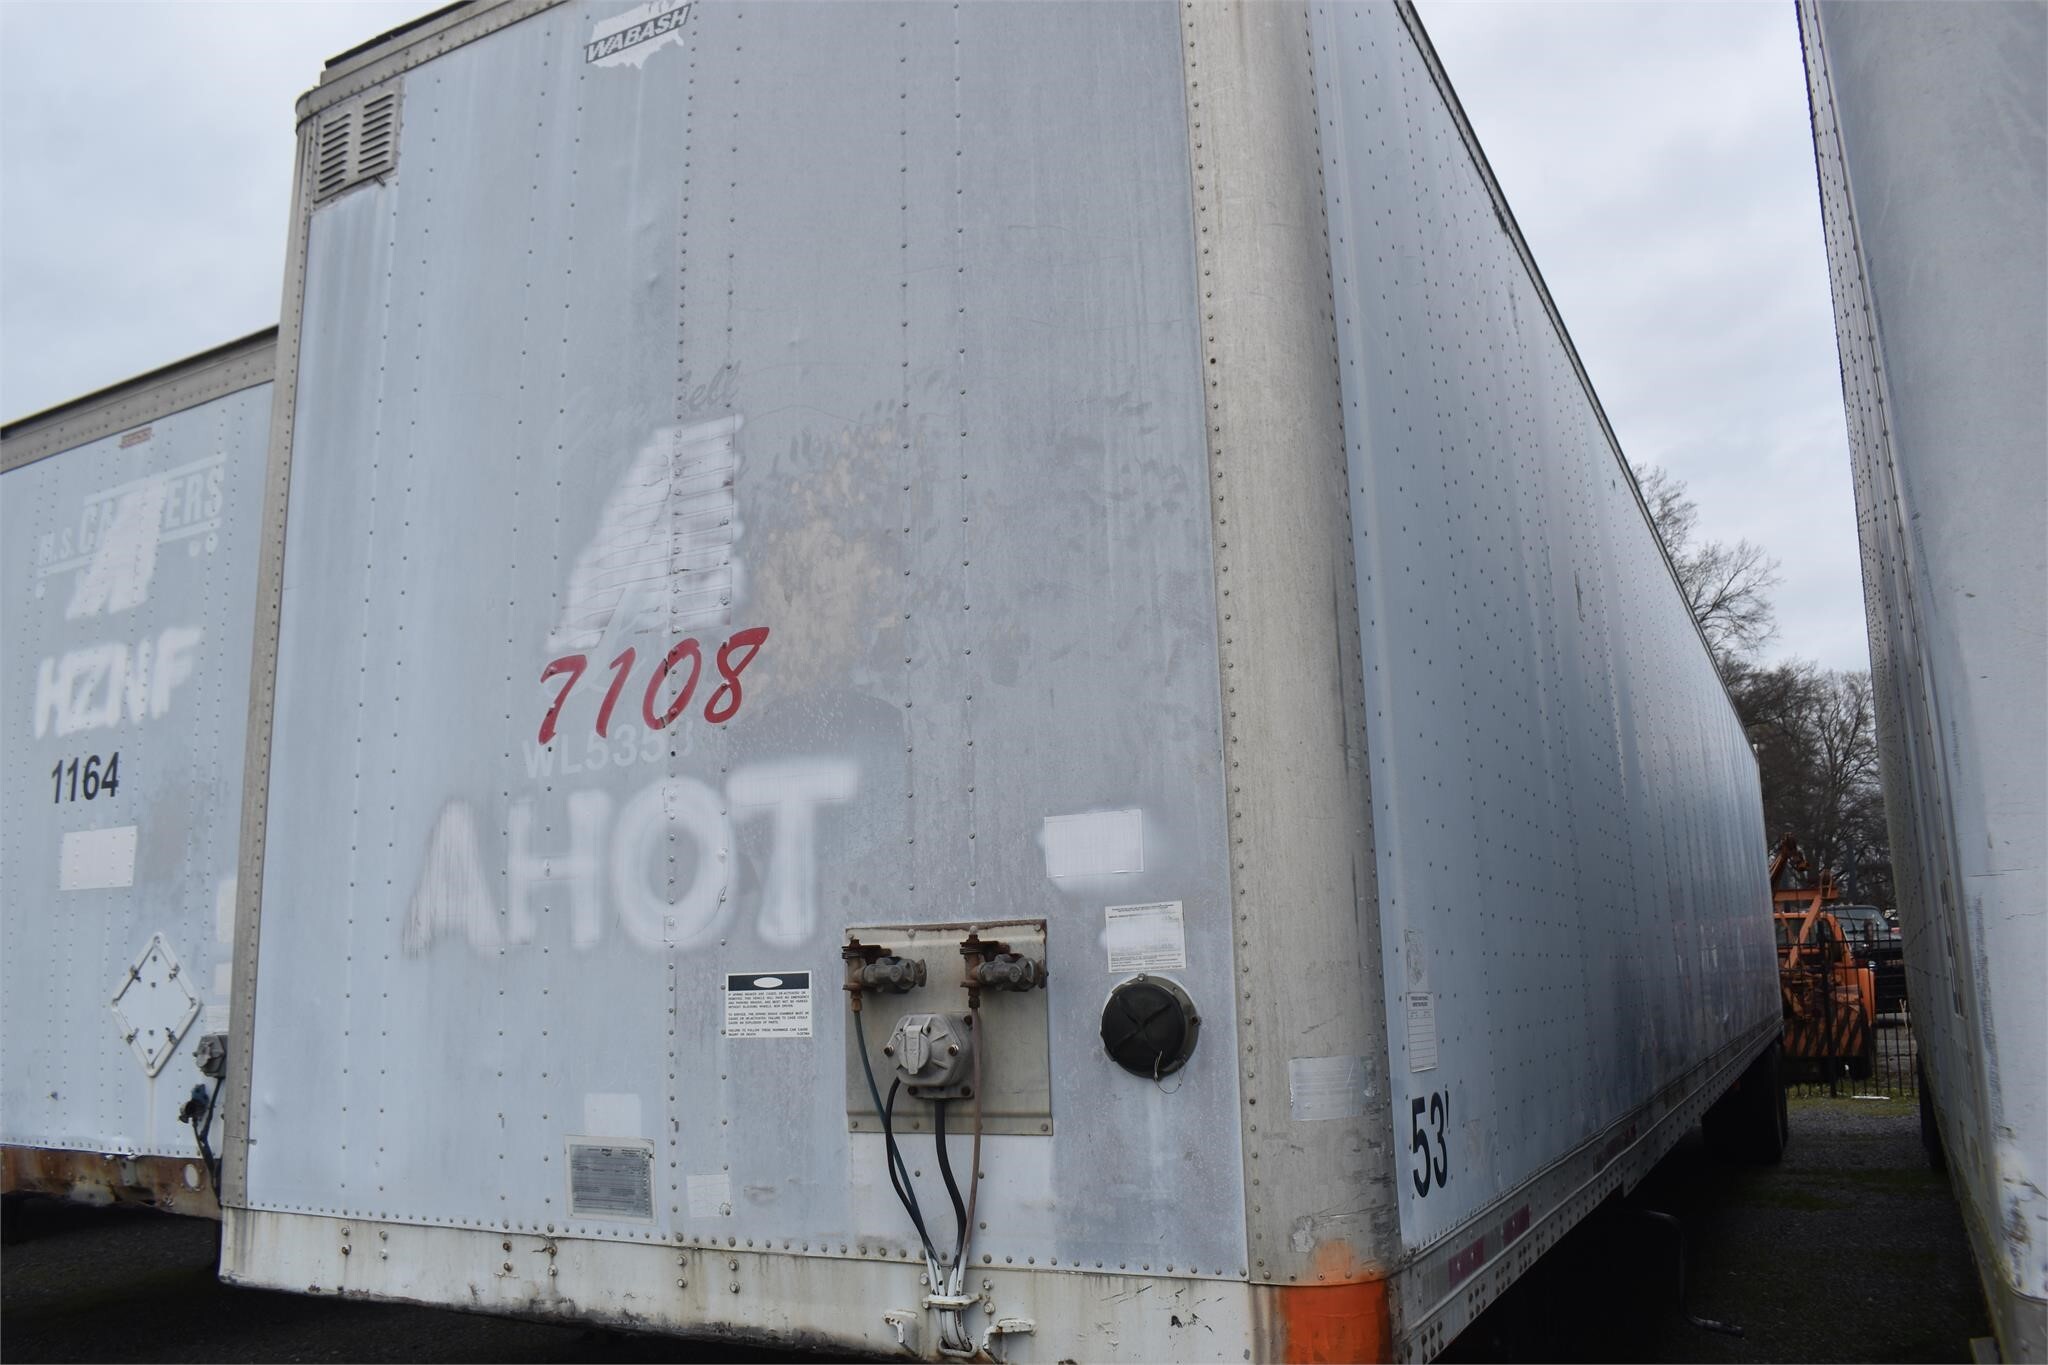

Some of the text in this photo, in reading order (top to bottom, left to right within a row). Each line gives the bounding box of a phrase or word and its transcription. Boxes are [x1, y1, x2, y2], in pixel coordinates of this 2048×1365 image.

[586, 5, 691, 62] WABASH
[538, 627, 770, 745] 7108
[52, 752, 119, 804] 1164
[402, 756, 858, 958] AHOT
[1411, 1090, 1449, 1198] 53'
